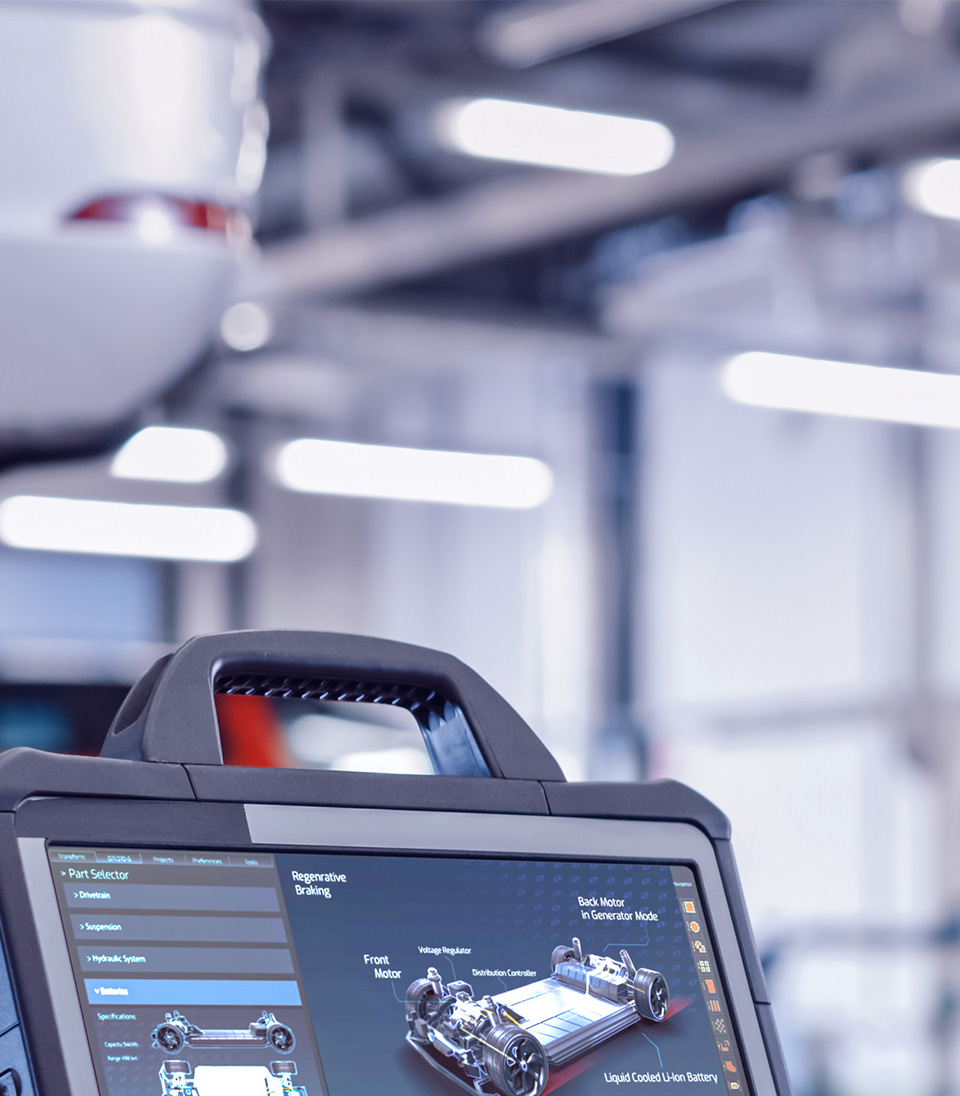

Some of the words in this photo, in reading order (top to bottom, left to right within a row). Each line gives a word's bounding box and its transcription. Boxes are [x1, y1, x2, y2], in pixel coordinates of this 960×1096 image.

[68, 868, 89, 879] Part
[90, 868, 129, 880] Selector
[291, 870, 347, 884] Regenrative
[78, 890, 111, 899] Drivetrain
[294, 884, 332, 898] Braking
[577, 896, 599, 907] Back
[600, 897, 625, 907] Motor
[581, 909, 590, 920] in
[591, 910, 633, 921] Generator
[634, 910, 659, 921] Mode
[85, 922, 122, 932] Suspension
[417, 946, 442, 955] Voltage
[442, 946, 472, 955] Regulator
[92, 954, 122, 964] Hydraulic
[122, 954, 146, 964] System
[363, 954, 390, 965] Front
[374, 968, 402, 979] Motor
[472, 968, 507, 977] Distribution
[507, 968, 537, 977] Controller
[604, 1072, 630, 1085] Liquid
[631, 1072, 661, 1083] Cooled
[662, 1072, 686, 1082] Li-Ion
[687, 1072, 718, 1084] Battery
